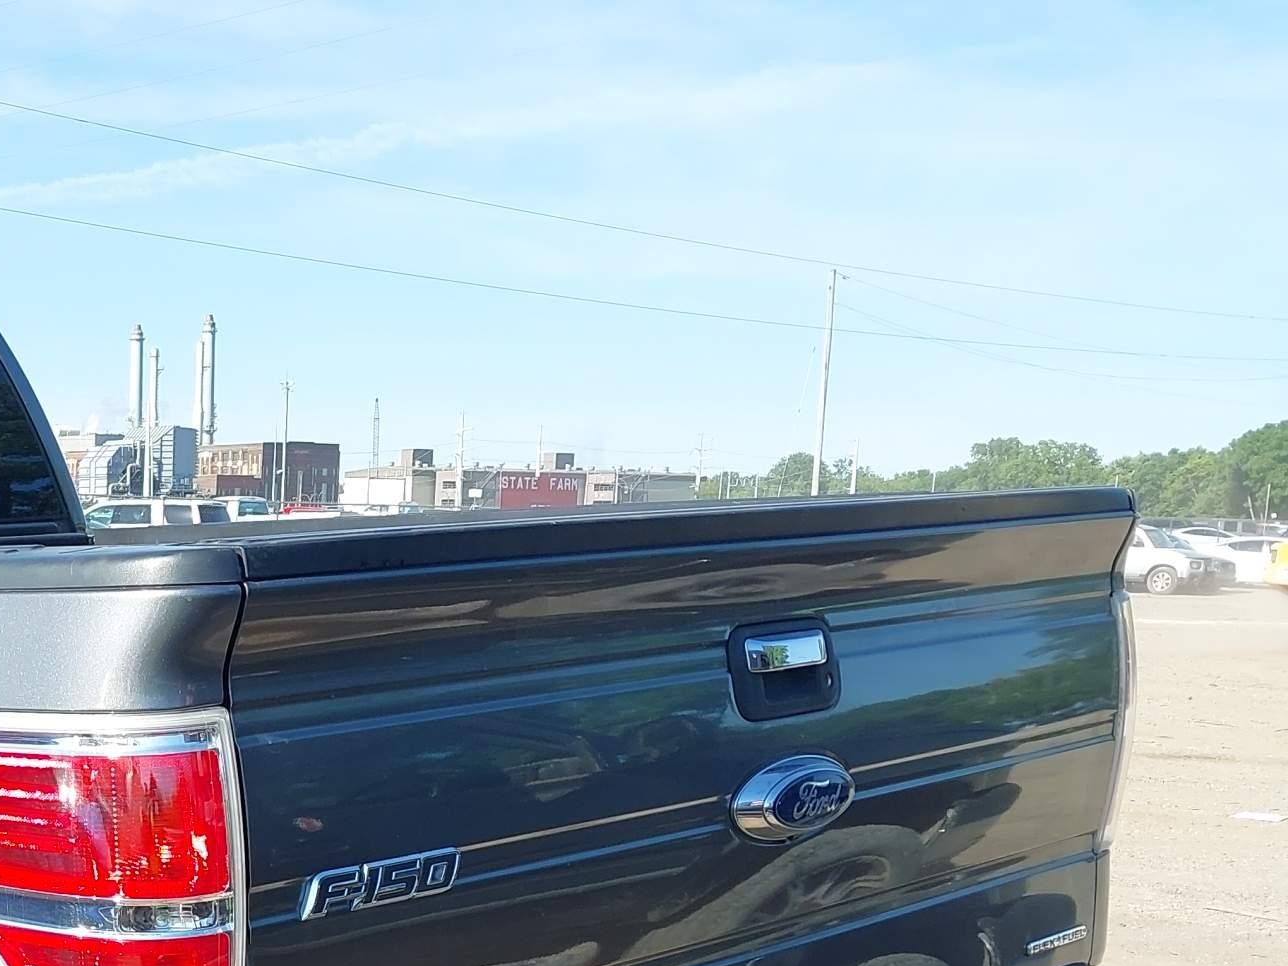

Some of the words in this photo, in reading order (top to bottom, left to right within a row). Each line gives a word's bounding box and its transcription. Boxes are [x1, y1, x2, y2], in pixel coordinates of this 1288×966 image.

[501, 476, 539, 490] STATE
[549, 477, 579, 491] FARM
[793, 779, 842, 820] Ford
[298, 847, 461, 921] F-150
